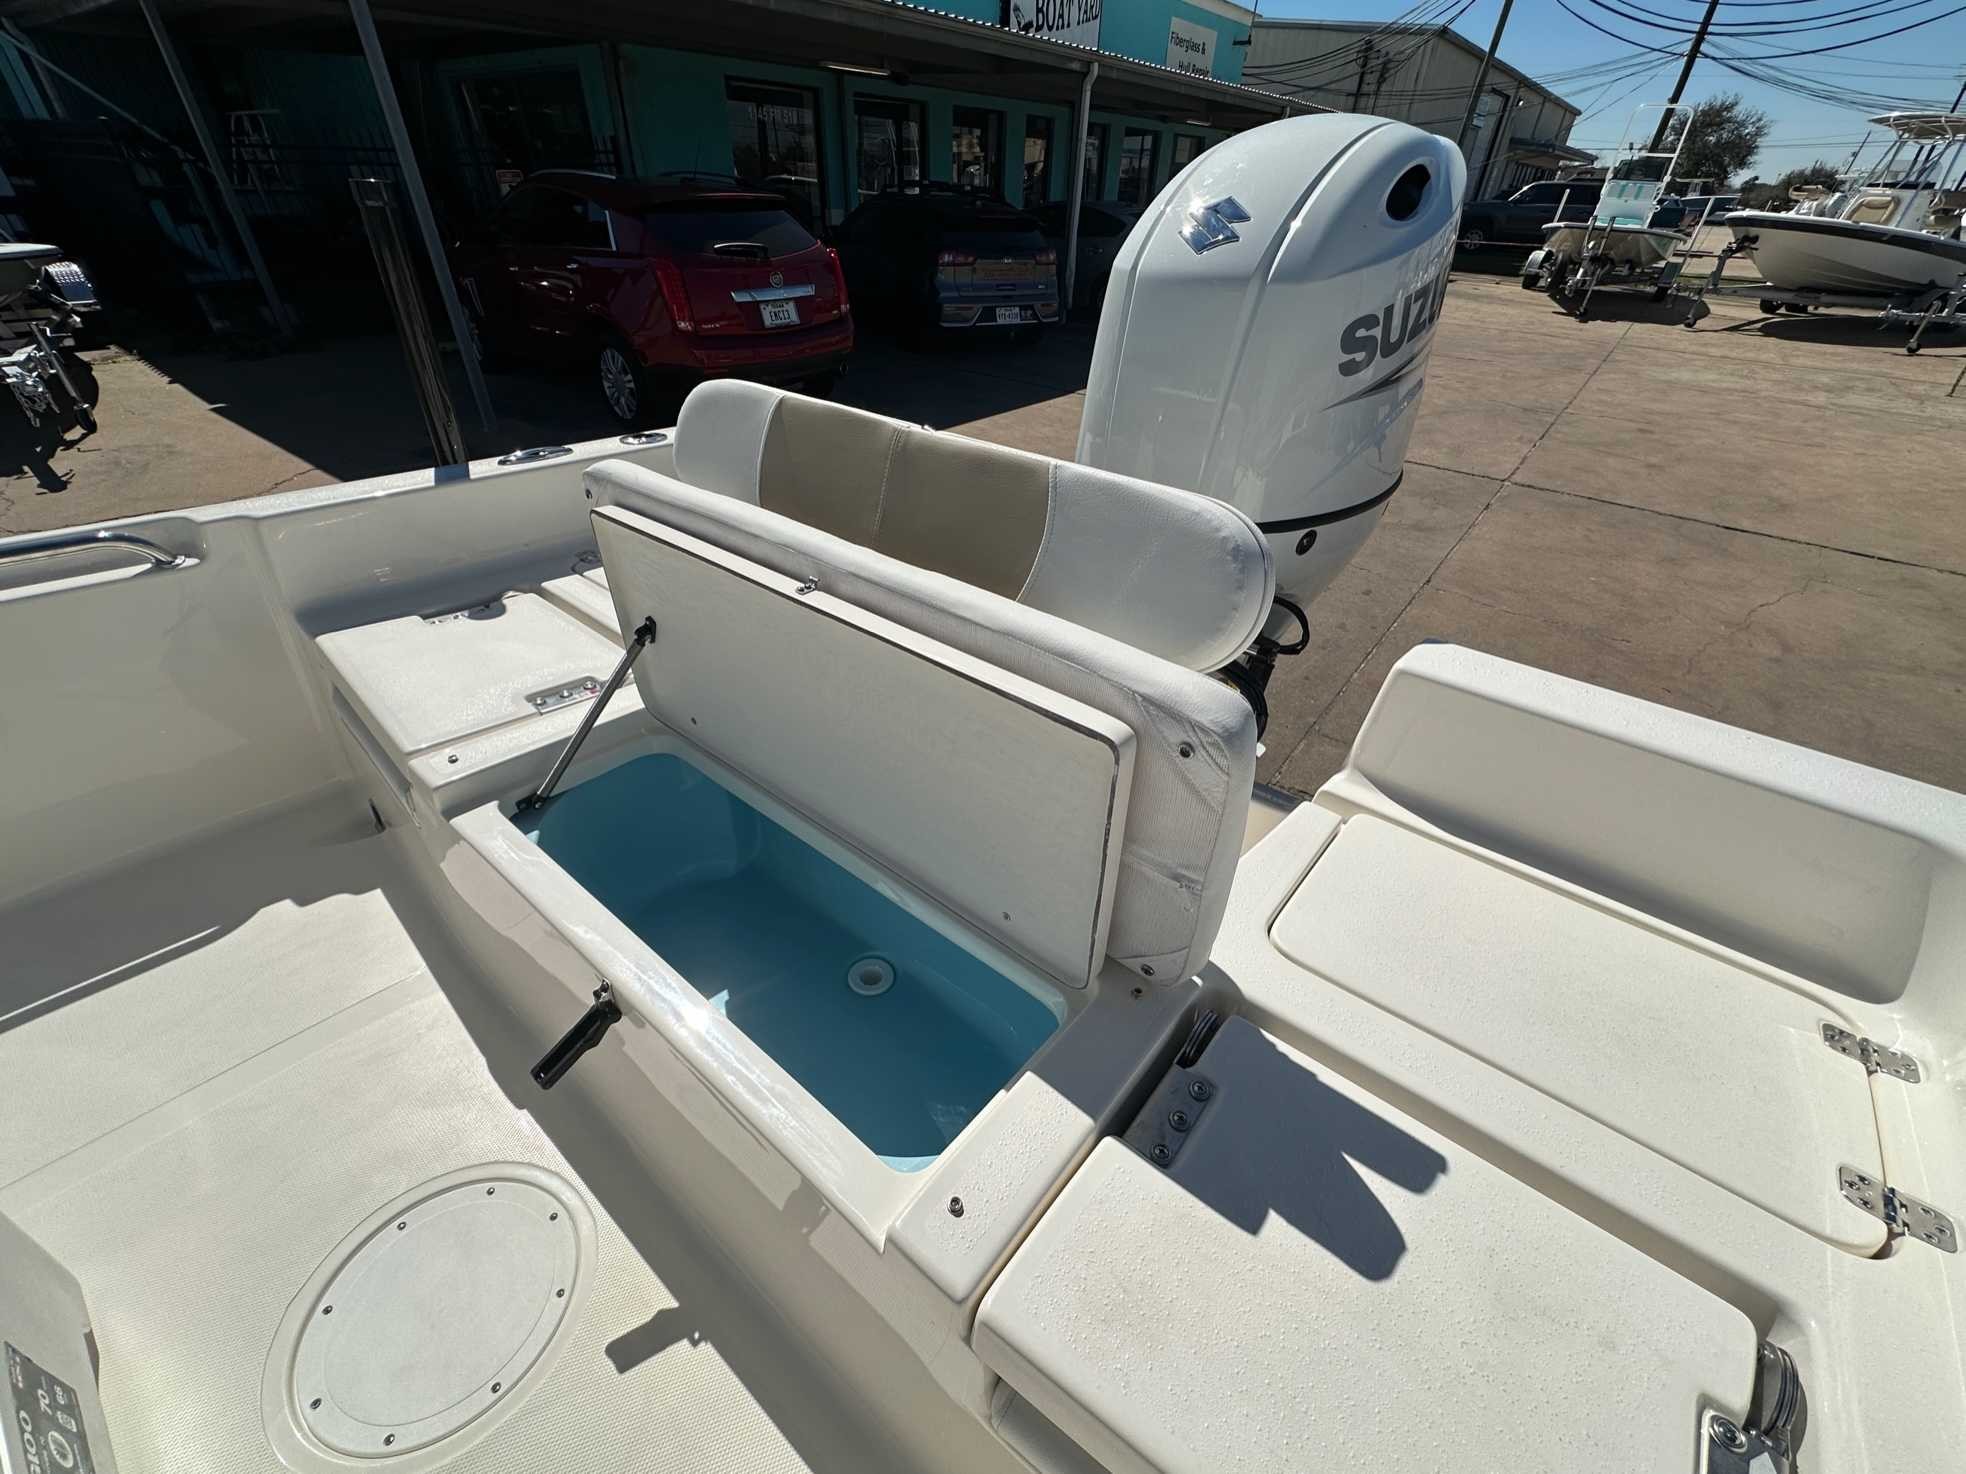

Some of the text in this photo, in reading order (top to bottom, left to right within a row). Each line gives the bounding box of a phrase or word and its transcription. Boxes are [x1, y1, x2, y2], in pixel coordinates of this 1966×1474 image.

[1035, 0, 1098, 33] BOAT YARD
[1170, 31, 1206, 55] Fiberglass &
